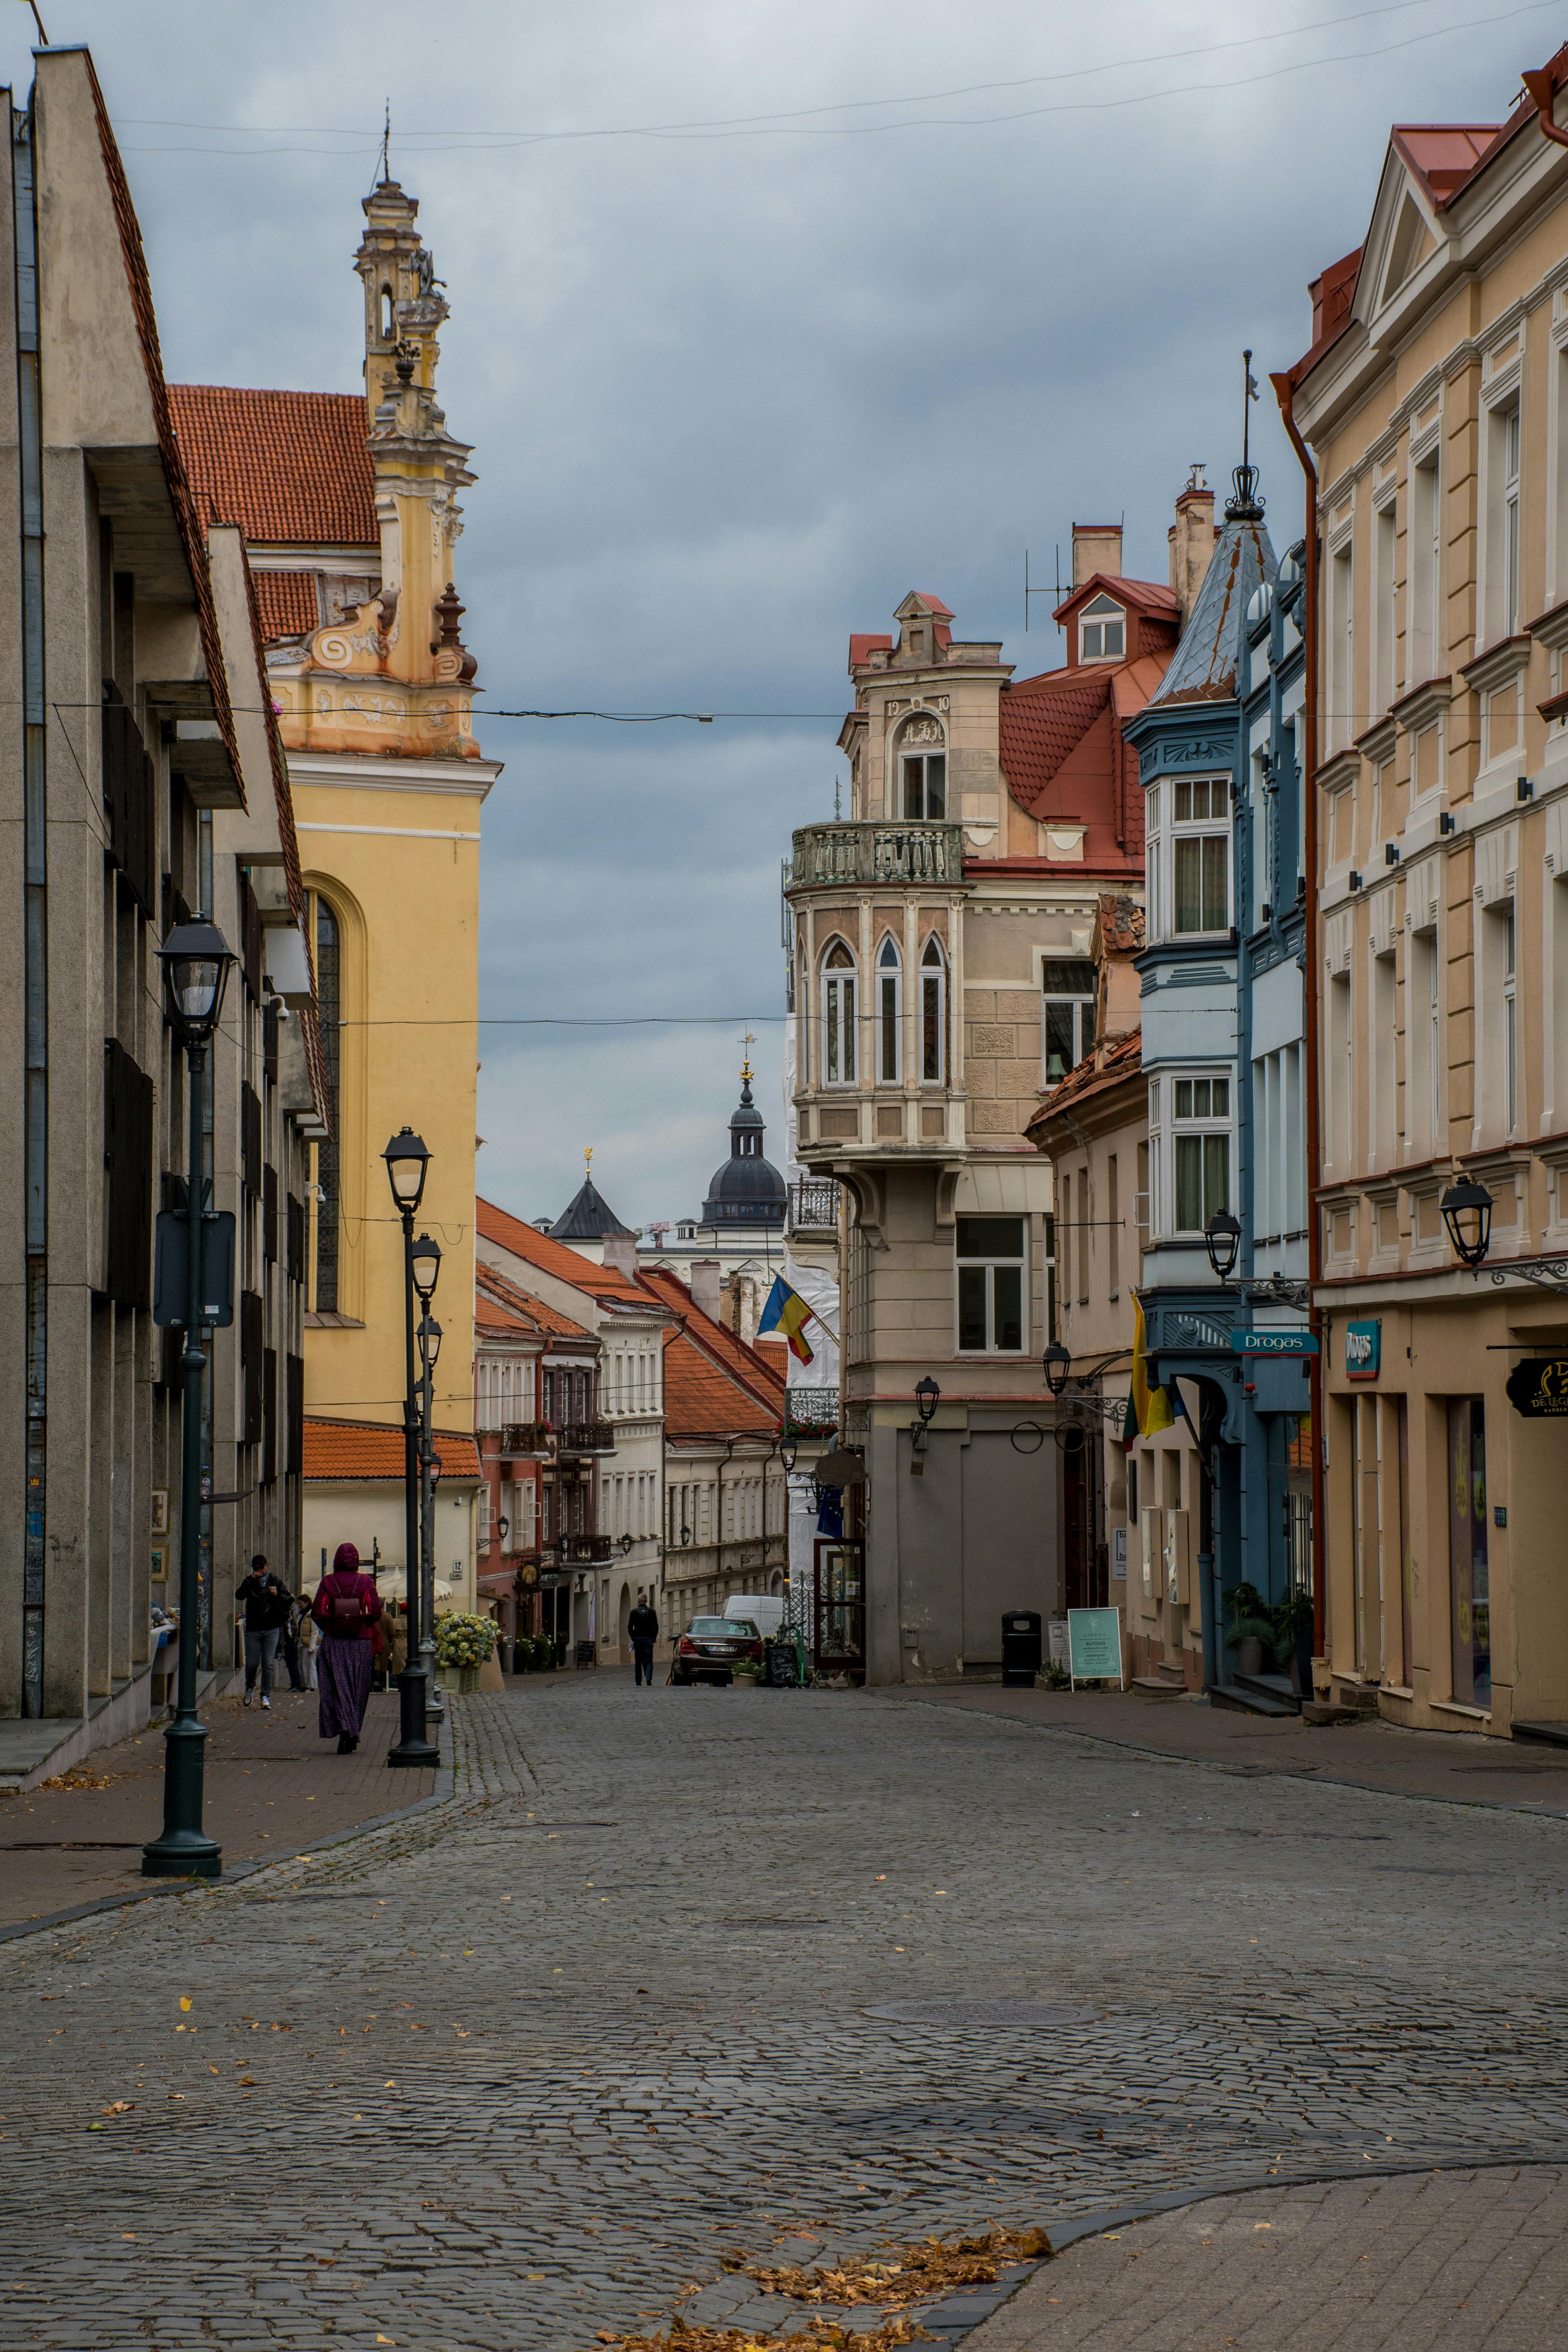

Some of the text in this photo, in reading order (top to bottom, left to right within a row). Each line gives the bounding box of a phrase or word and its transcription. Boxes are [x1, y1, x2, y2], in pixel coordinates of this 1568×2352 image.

[887, 696, 949, 716] 19 10
[1246, 1336, 1303, 1350] Drogas
[1530, 1399, 1547, 1407] DE
[455, 1562, 461, 1570] 12
